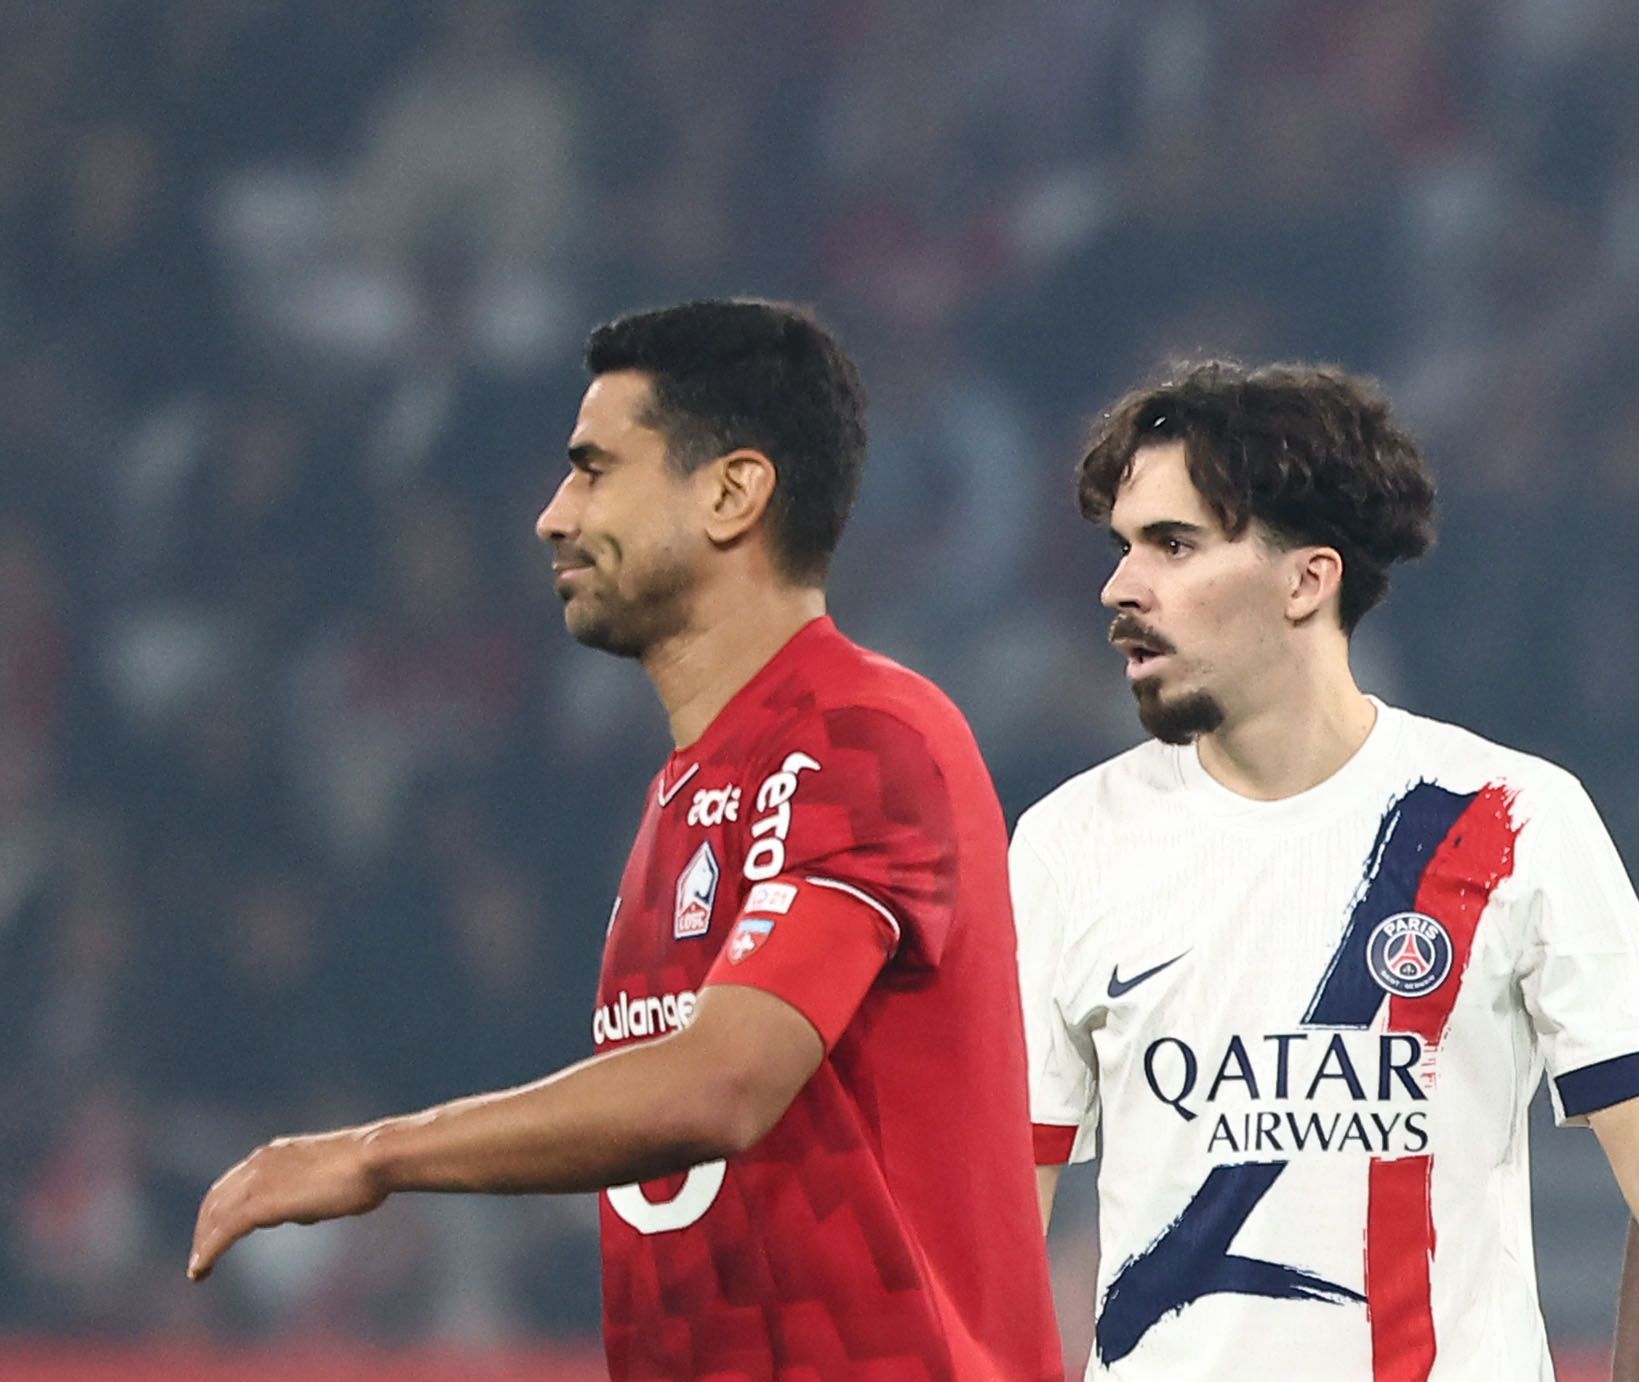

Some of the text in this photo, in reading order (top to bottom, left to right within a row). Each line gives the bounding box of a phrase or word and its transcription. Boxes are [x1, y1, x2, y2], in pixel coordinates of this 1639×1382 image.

[1383, 917, 1439, 940] PARIS
[593, 990, 698, 1045] oulange
[1144, 1033, 1429, 1122] QATAR
[1207, 1111, 1429, 1152] AIRWAYS
